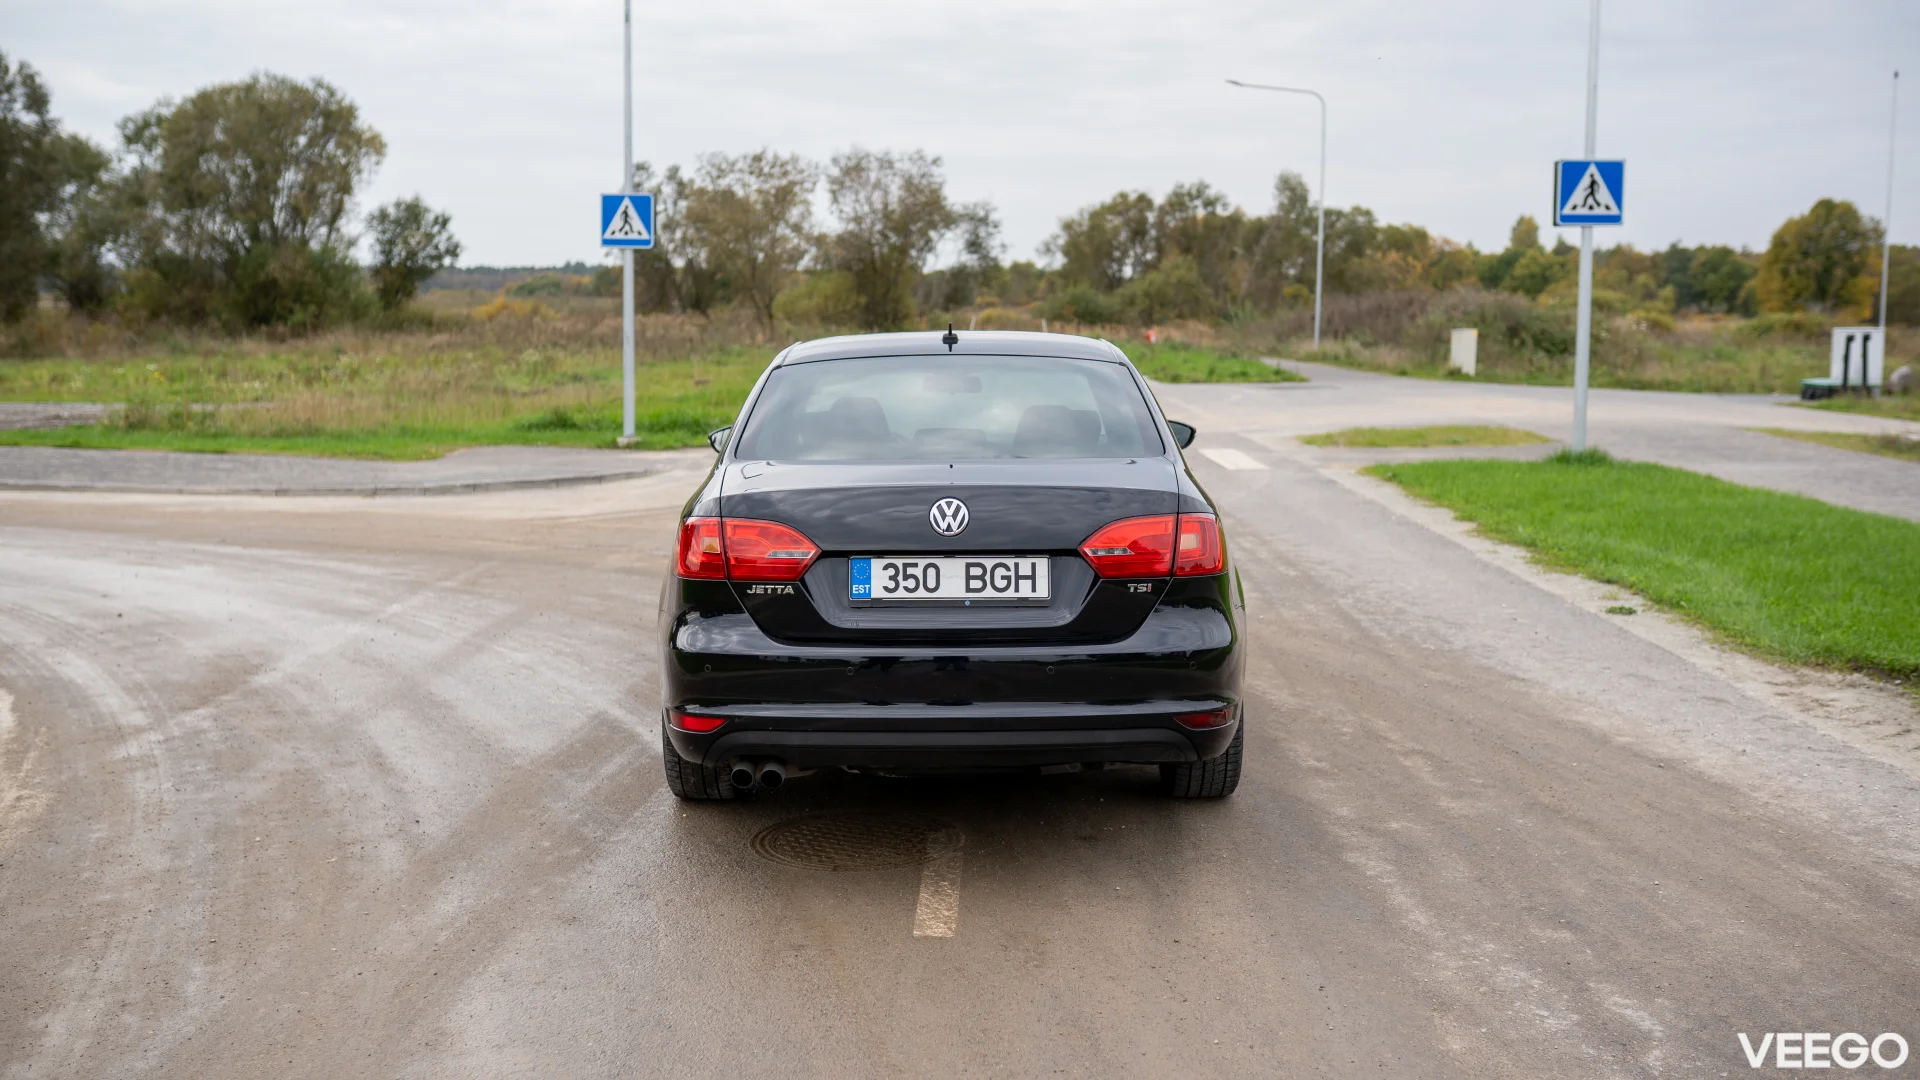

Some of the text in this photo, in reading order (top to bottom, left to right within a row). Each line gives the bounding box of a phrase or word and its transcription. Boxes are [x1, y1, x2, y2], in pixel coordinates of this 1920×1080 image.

[930, 498, 969, 536] VW
[882, 561, 1037, 594] 350 BGH
[746, 585, 795, 595] JETTA
[852, 584, 871, 594] EST
[1127, 583, 1152, 593] TSI
